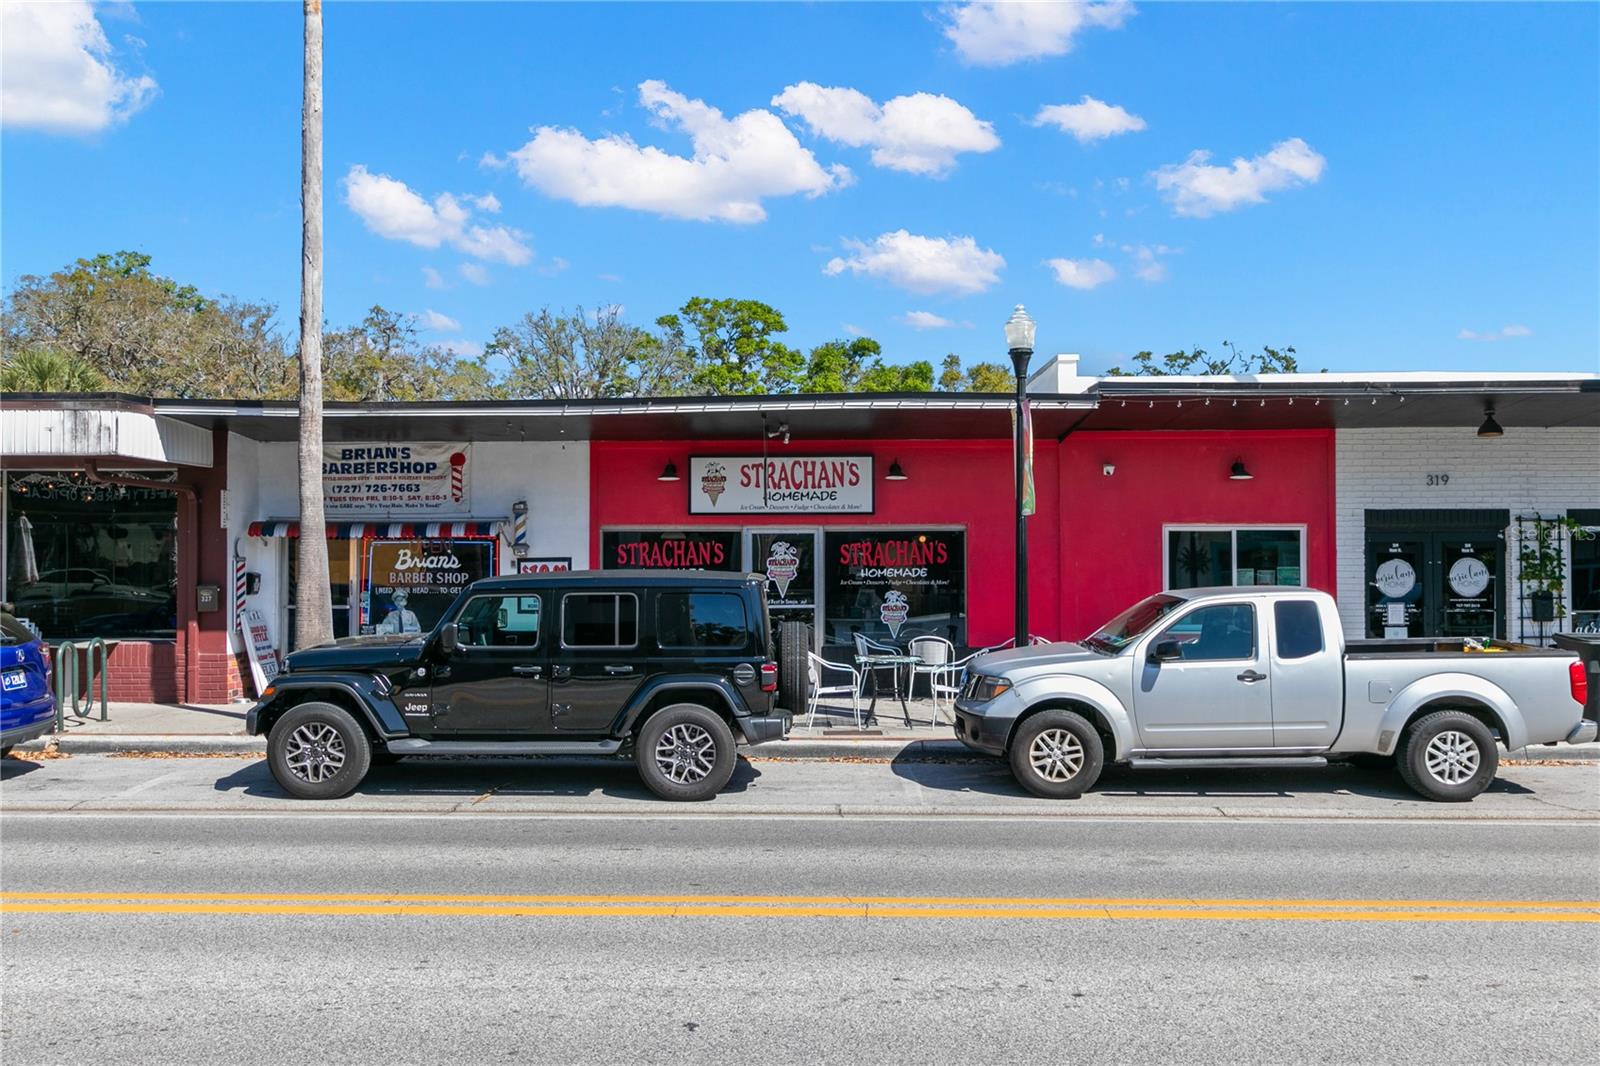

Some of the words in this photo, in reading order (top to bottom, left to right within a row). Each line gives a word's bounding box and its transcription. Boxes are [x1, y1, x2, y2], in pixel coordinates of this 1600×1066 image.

[341, 446, 411, 461] BRIAN'S
[740, 460, 860, 490] STRACHAN'S
[1426, 474, 1450, 487] 319
[332, 484, 361, 494] (727)
[365, 483, 421, 493] 726-7663
[763, 490, 838, 501] HOMEMADE
[394, 549, 462, 570] Brian's
[617, 540, 724, 567] STRACHAN'S
[840, 540, 948, 567] STRACHAN'S
[389, 572, 433, 584] BARBER
[436, 572, 469, 584] SHOP
[860, 568, 928, 577] HOMEMADE
[379, 586, 394, 594] NEED
[440, 586, 448, 594] TO
[450, 586, 462, 594] GET
[404, 702, 428, 712] Jeep
